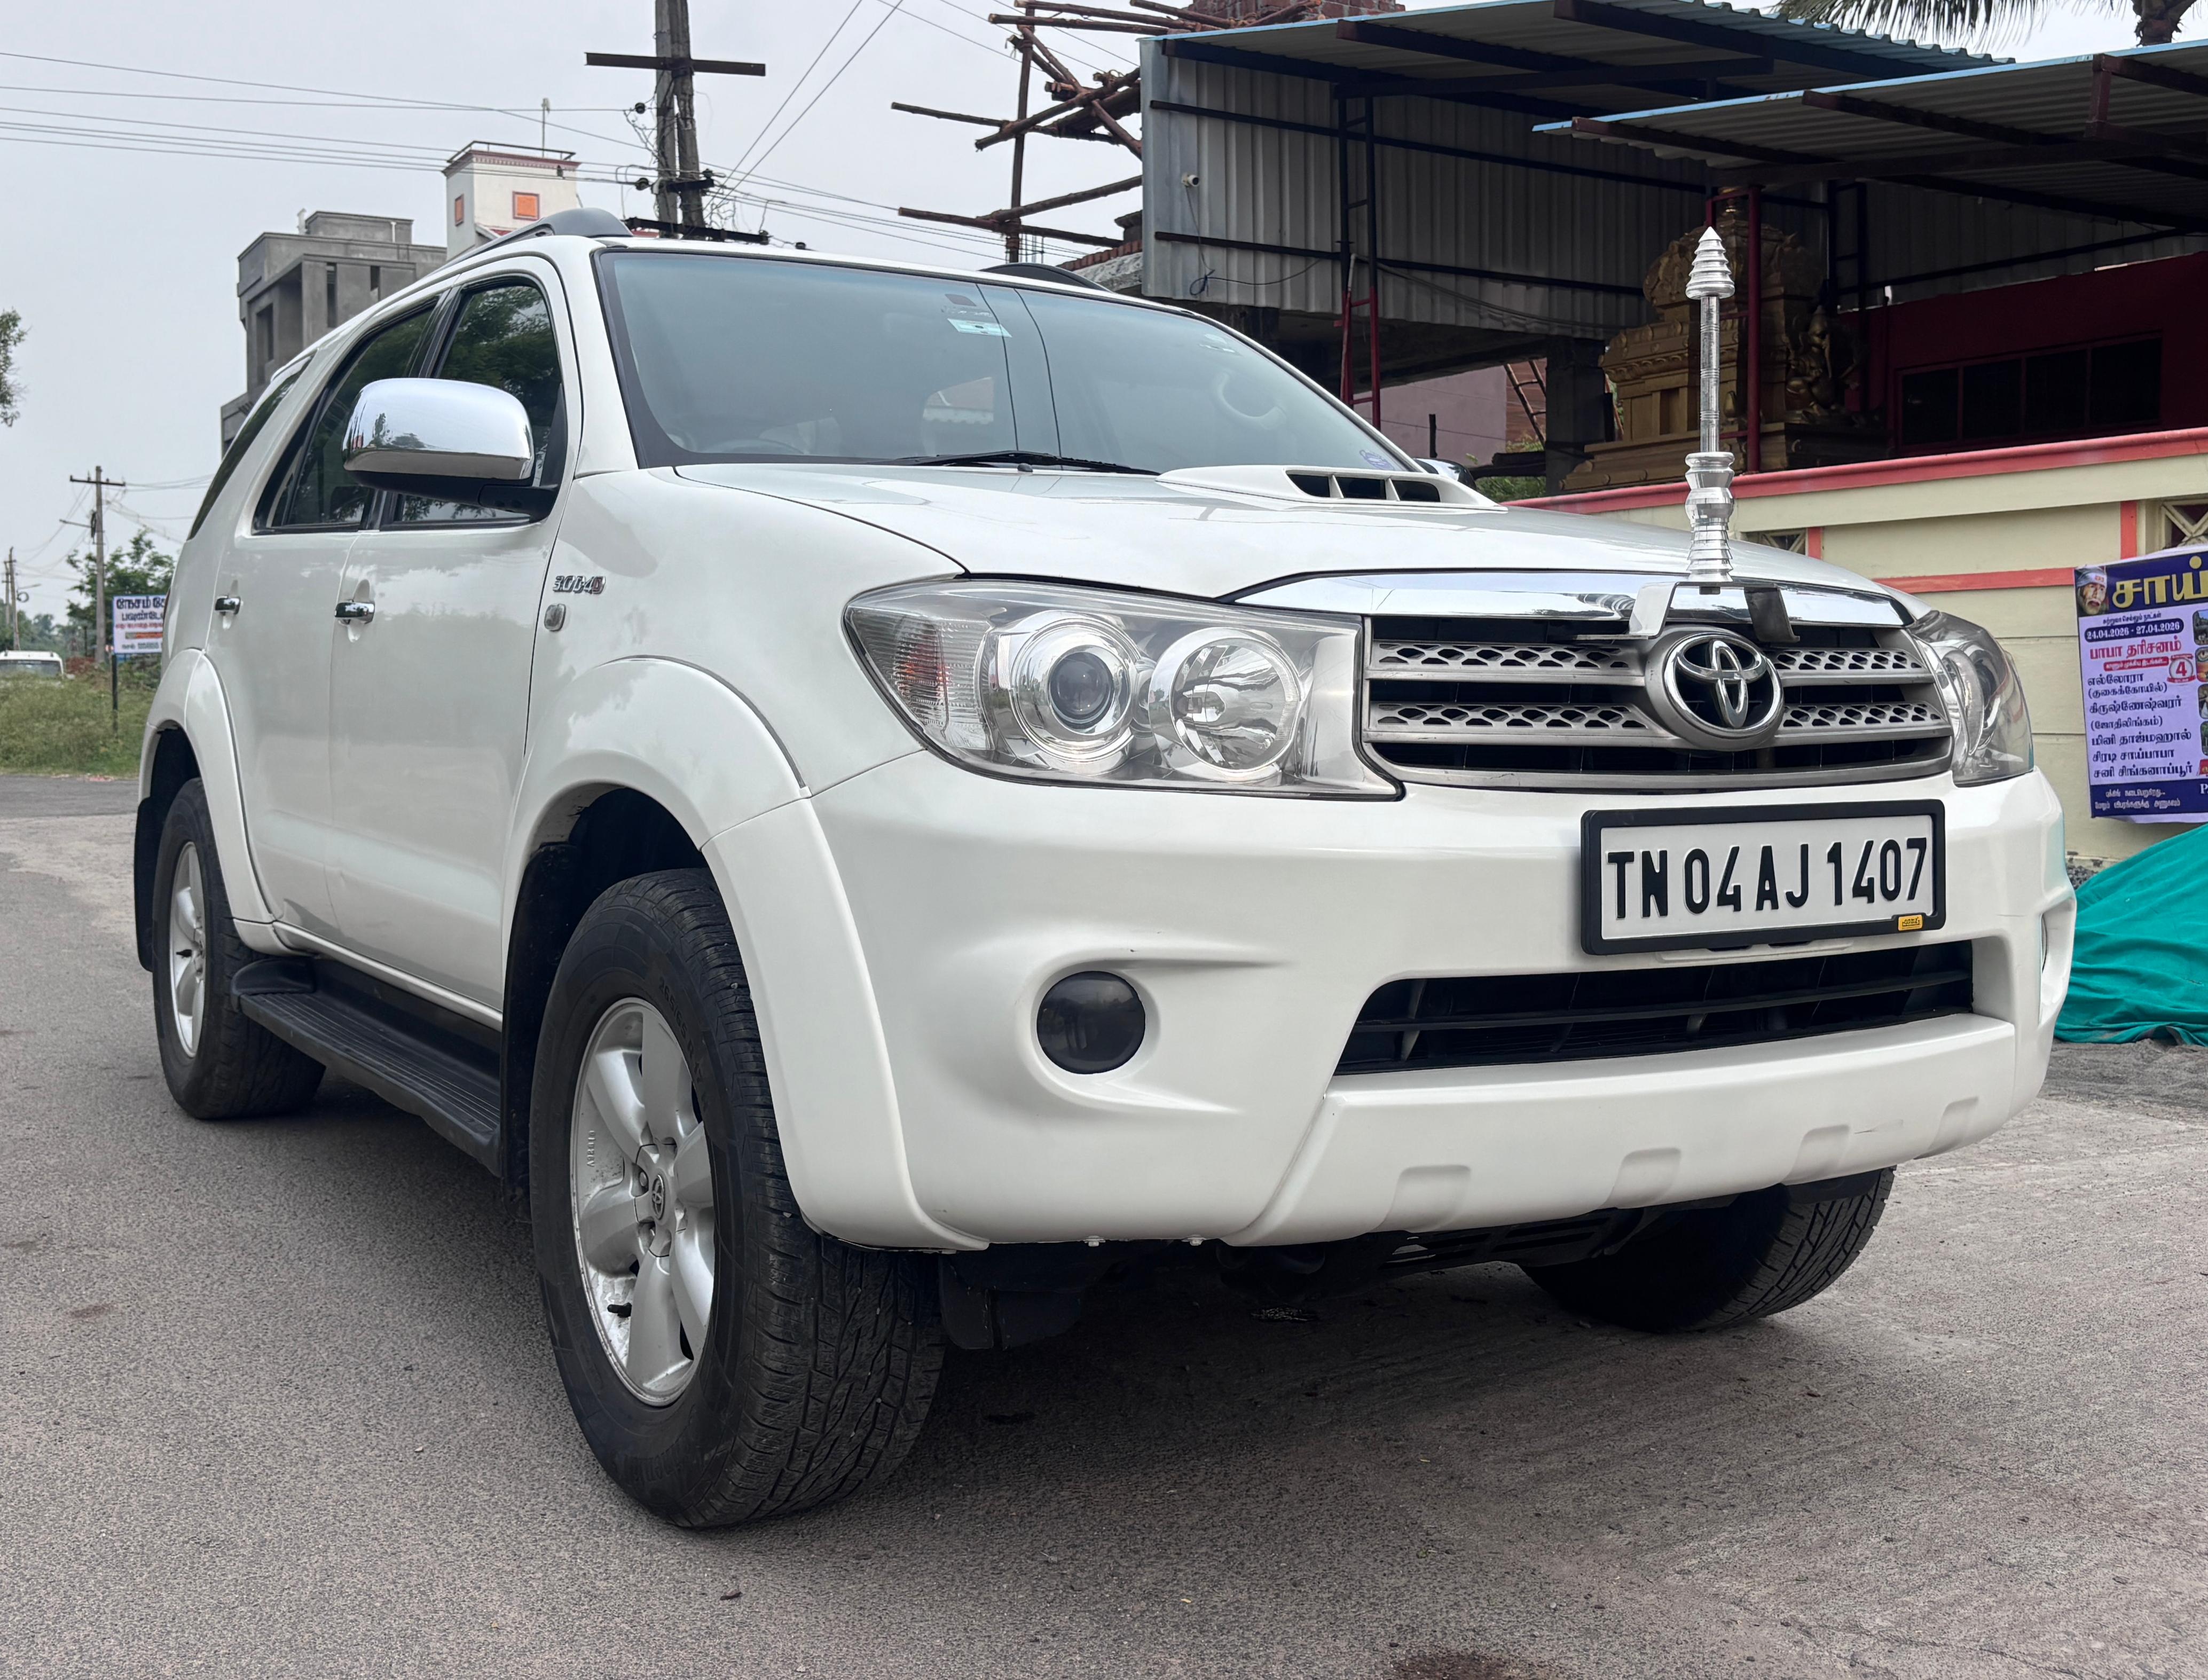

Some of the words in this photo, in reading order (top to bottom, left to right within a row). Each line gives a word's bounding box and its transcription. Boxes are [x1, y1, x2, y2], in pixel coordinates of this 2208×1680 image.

[2087, 627, 2130, 640] 24.04.2026
[2136, 621, 2180, 634] 27.04.2026
[2090, 646, 2123, 660] பாபா
[2127, 635, 2182, 658] தரிசனம்
[2175, 661, 2188, 677] 4
[2087, 673, 2144, 686] எல்லோரா
[2092, 734, 2116, 745] மினி
[2120, 748, 2174, 760] சாய்பாபா
[2094, 766, 2115, 778] சனி
[1607, 850, 1668, 918] TN
[1684, 845, 1742, 914] 04
[1755, 843, 1809, 912] AJ
[1827, 837, 1927, 906] 1407
